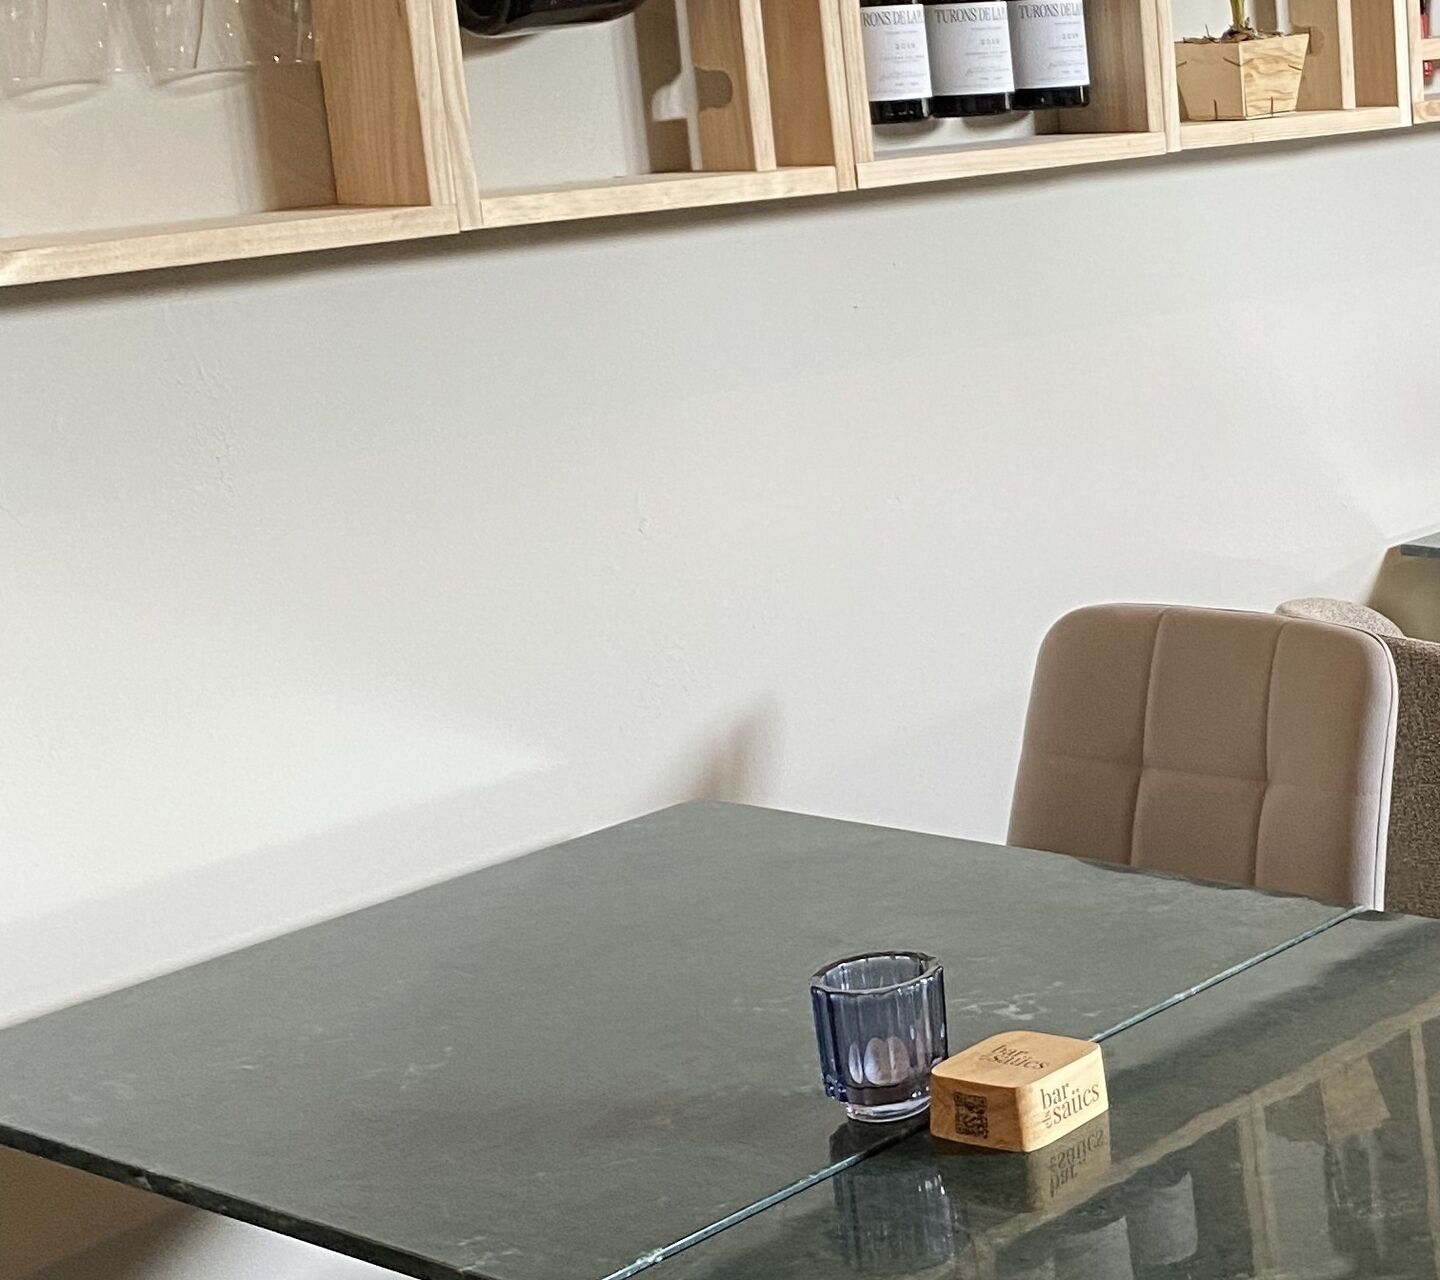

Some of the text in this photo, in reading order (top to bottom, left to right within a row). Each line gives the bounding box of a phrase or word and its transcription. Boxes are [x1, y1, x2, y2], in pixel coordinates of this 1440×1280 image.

[862, 10, 891, 28] RONS
[1040, 1082, 1070, 1110] bar
[1053, 1083, 1100, 1125] saücs
